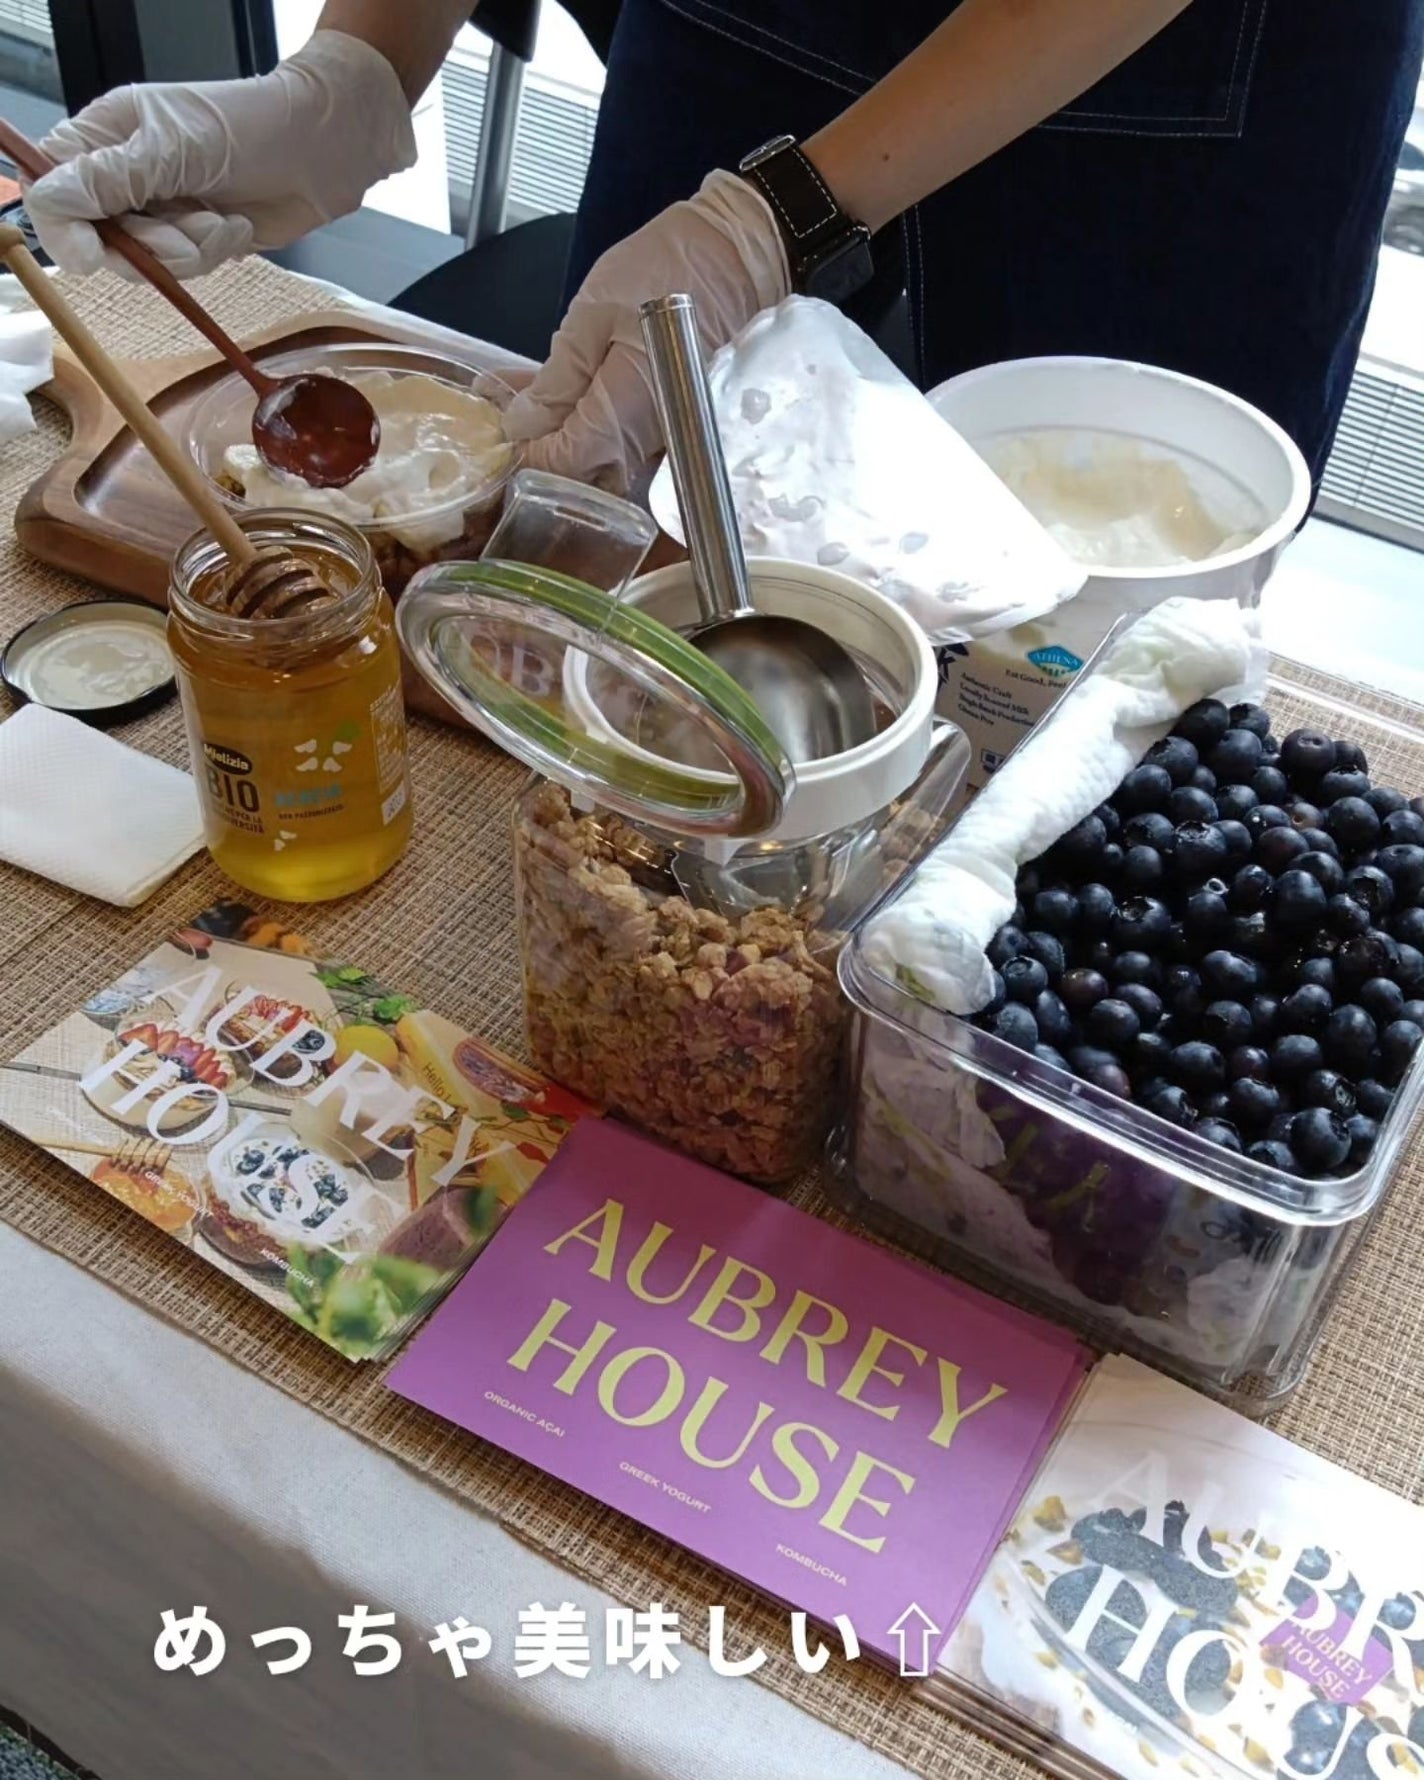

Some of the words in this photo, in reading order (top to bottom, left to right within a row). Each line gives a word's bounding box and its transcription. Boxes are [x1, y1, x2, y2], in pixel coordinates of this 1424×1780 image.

[206, 764, 260, 813] BIO
[140, 966, 517, 1187] AUBREY
[79, 1038, 409, 1266] HOUSE
[260, 1248, 315, 1288] KOMBUCHA
[542, 1198, 1008, 1449] AUBREY
[483, 1389, 537, 1424] ORGANIC
[536, 1418, 566, 1440] AÇAI
[507, 1297, 917, 1555] HOUSE
[618, 1460, 661, 1488] GREEK
[661, 1480, 712, 1515] YOGURT
[775, 1543, 849, 1587] KOMBUCHA
[1281, 1635, 1351, 1699] HOUSE
